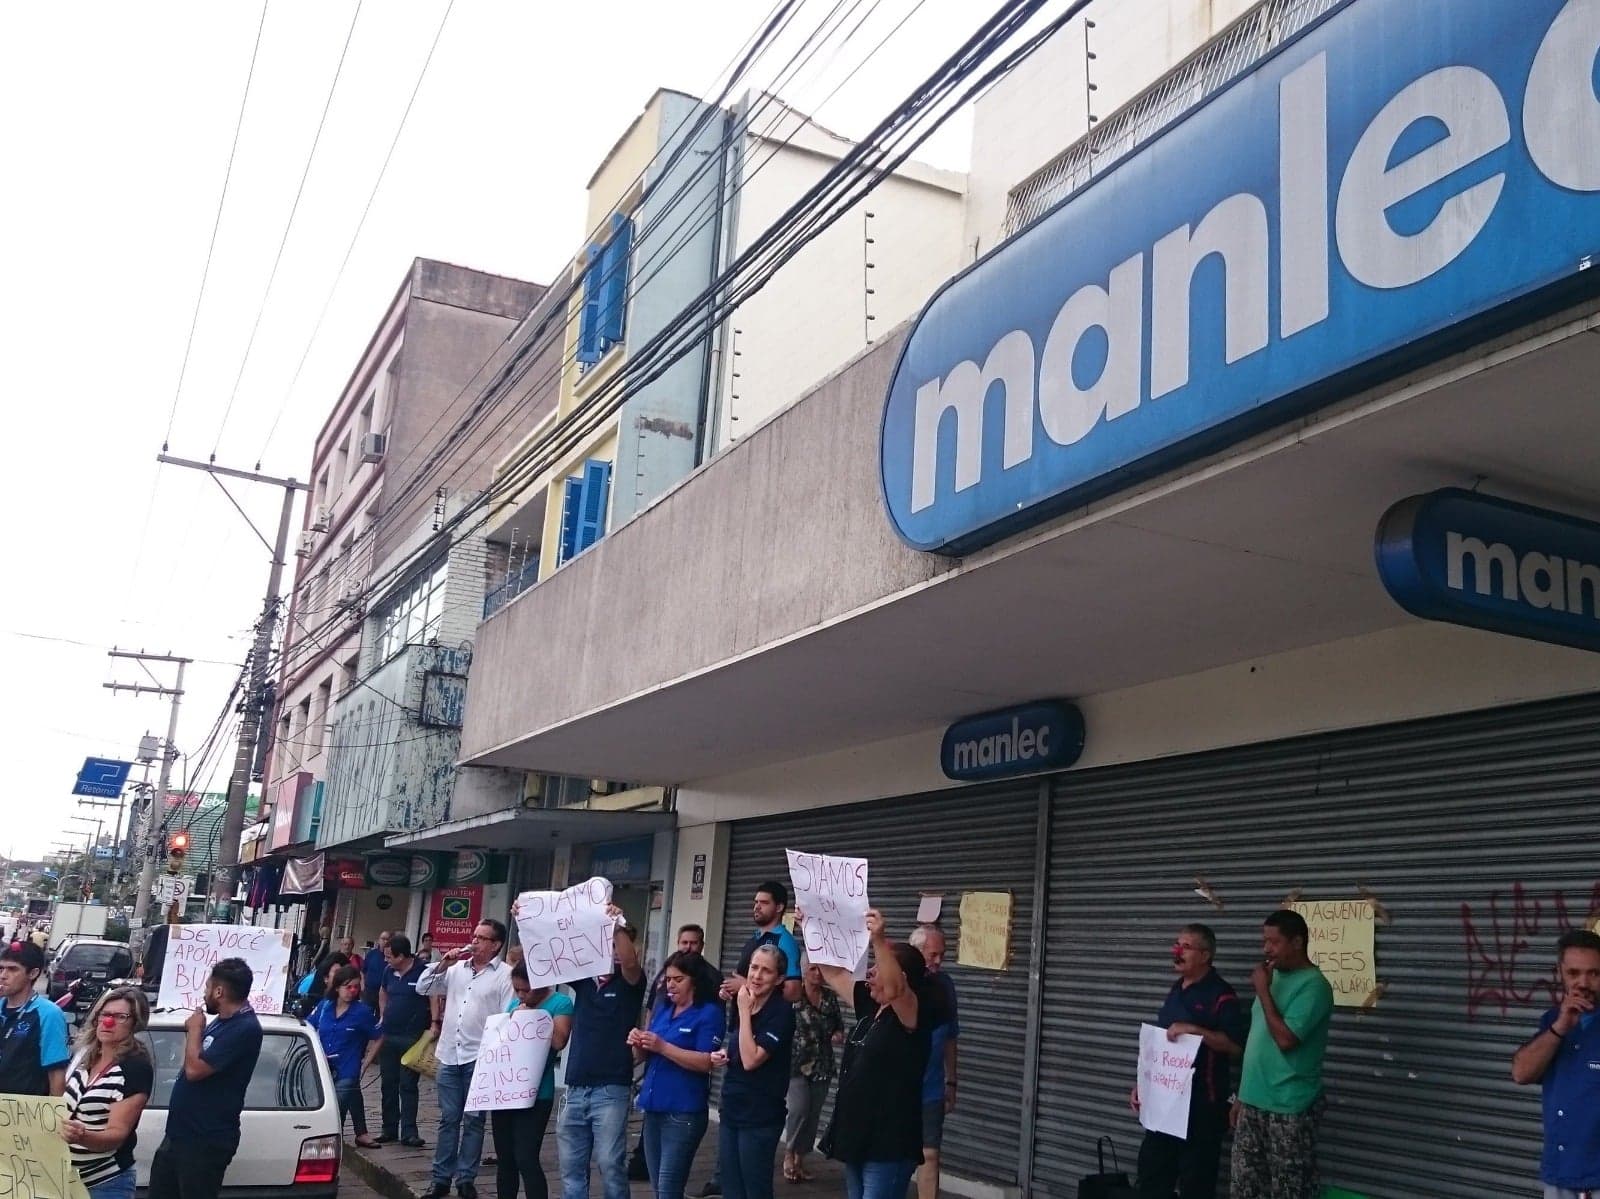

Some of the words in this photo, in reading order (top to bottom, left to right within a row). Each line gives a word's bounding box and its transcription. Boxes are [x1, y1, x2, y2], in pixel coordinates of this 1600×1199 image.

[953, 716, 1050, 772] manlec
[460, 889, 475, 897] TEM
[435, 927, 473, 935] POPULAR
[556, 916, 574, 931] EM
[180, 927, 211, 943] SE
[217, 928, 267, 951] VOCÊ
[13, 1133, 33, 1153] EM
